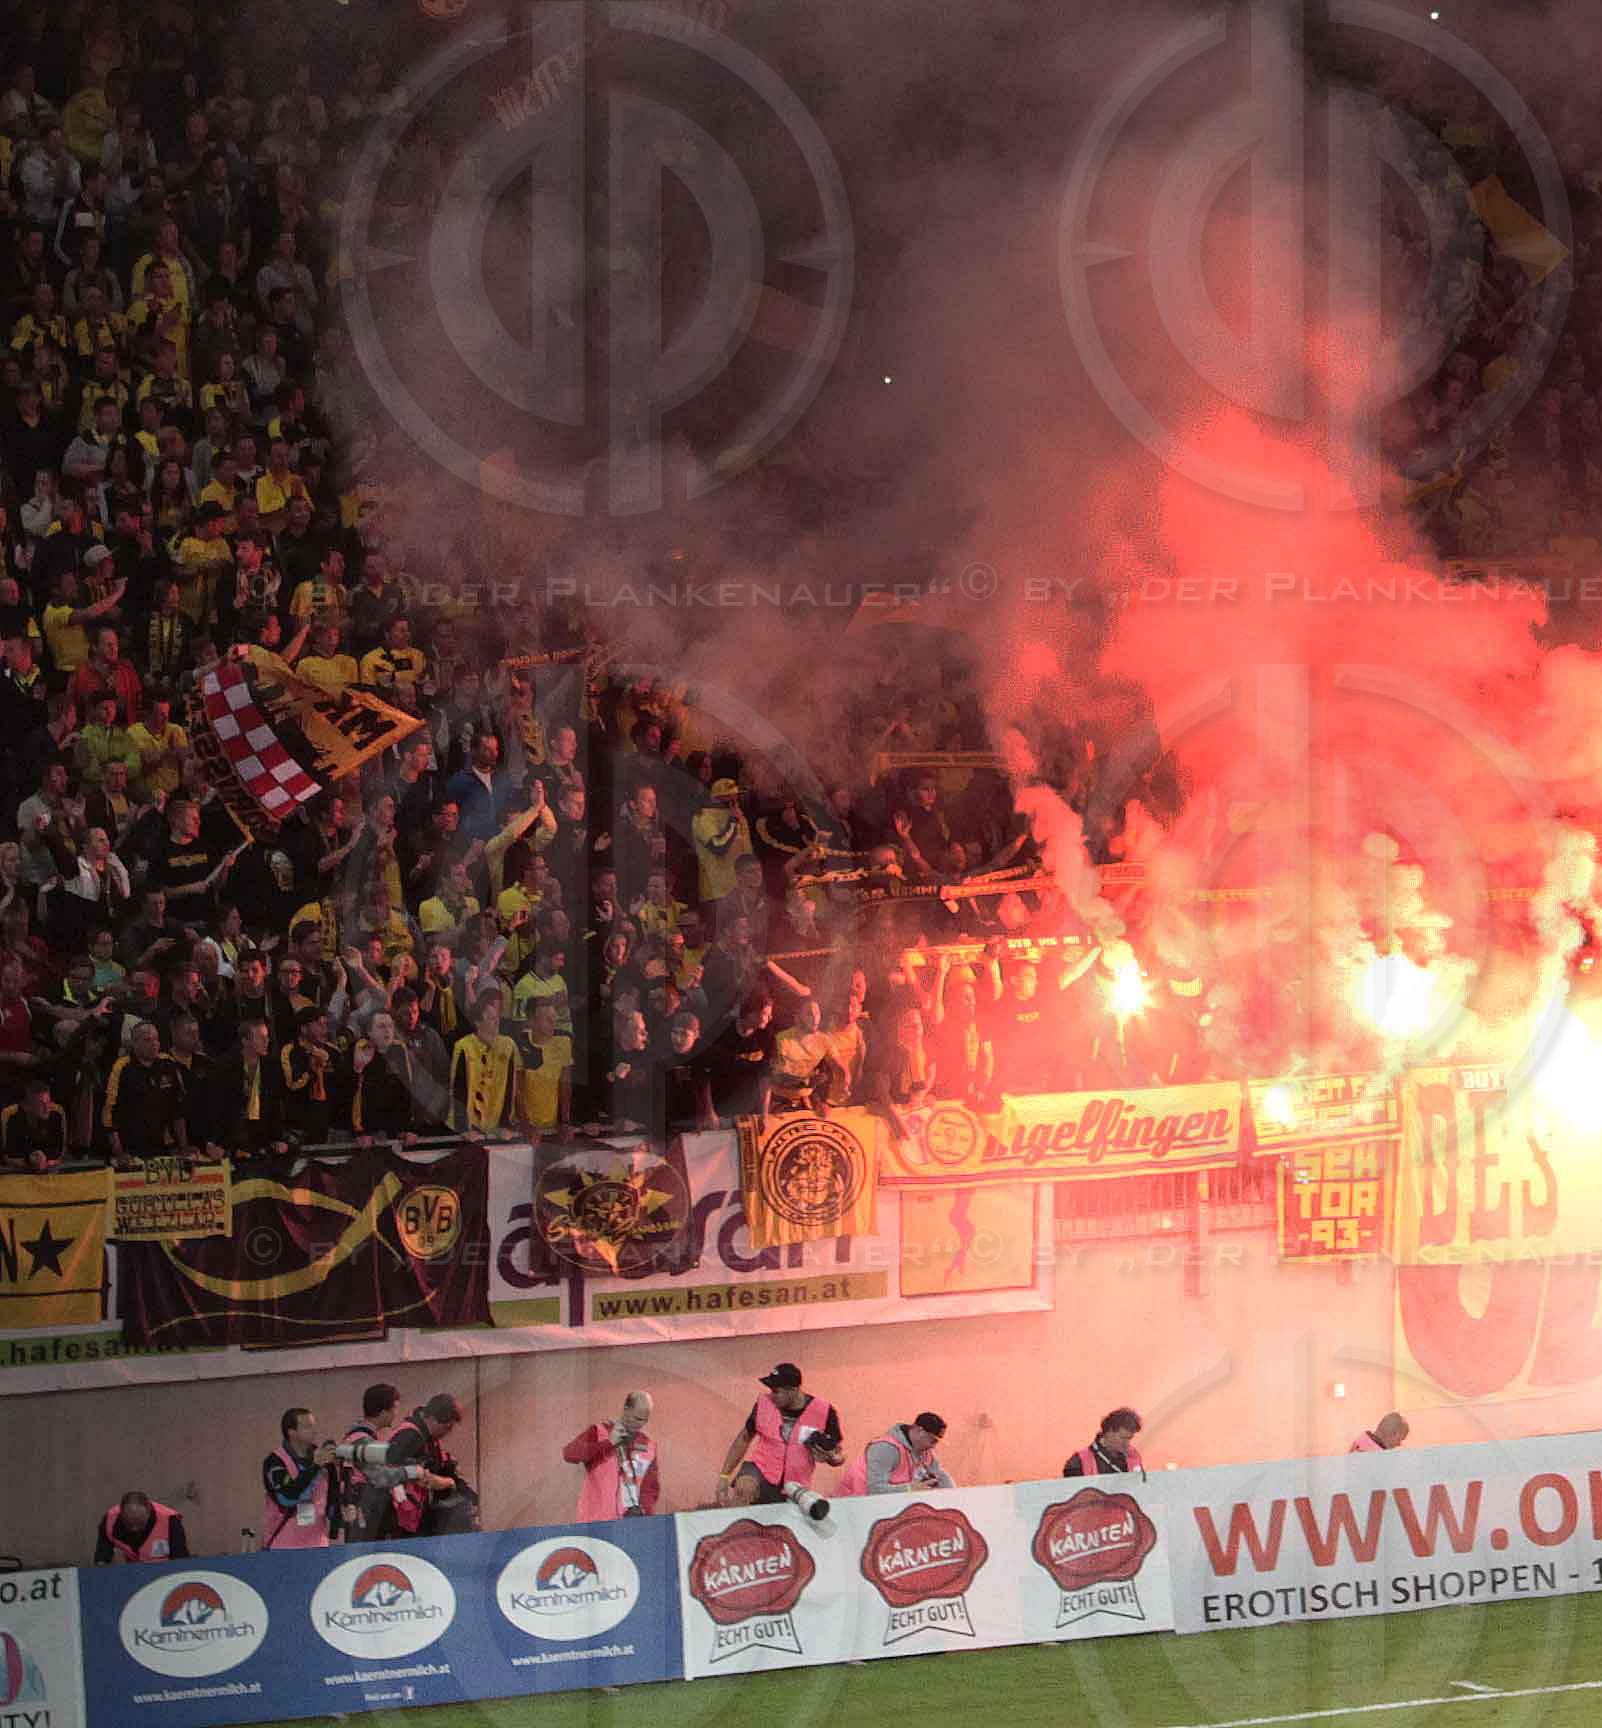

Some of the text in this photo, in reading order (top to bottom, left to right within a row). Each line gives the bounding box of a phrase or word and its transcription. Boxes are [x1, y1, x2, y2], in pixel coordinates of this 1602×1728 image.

[403, 1191, 455, 1237] BVB
[1293, 1182, 1379, 1220] TOR
[598, 1278, 852, 1319] www.hafesan.at
[1062, 1584, 1135, 1614] ECHT GUT!
[1202, 1572, 1380, 1624] EROTISCH
[1391, 1562, 1557, 1606] SHOPPEN
[717, 1617, 793, 1649] ECHT GUT!
[891, 1600, 966, 1631] ECHT GUT!
